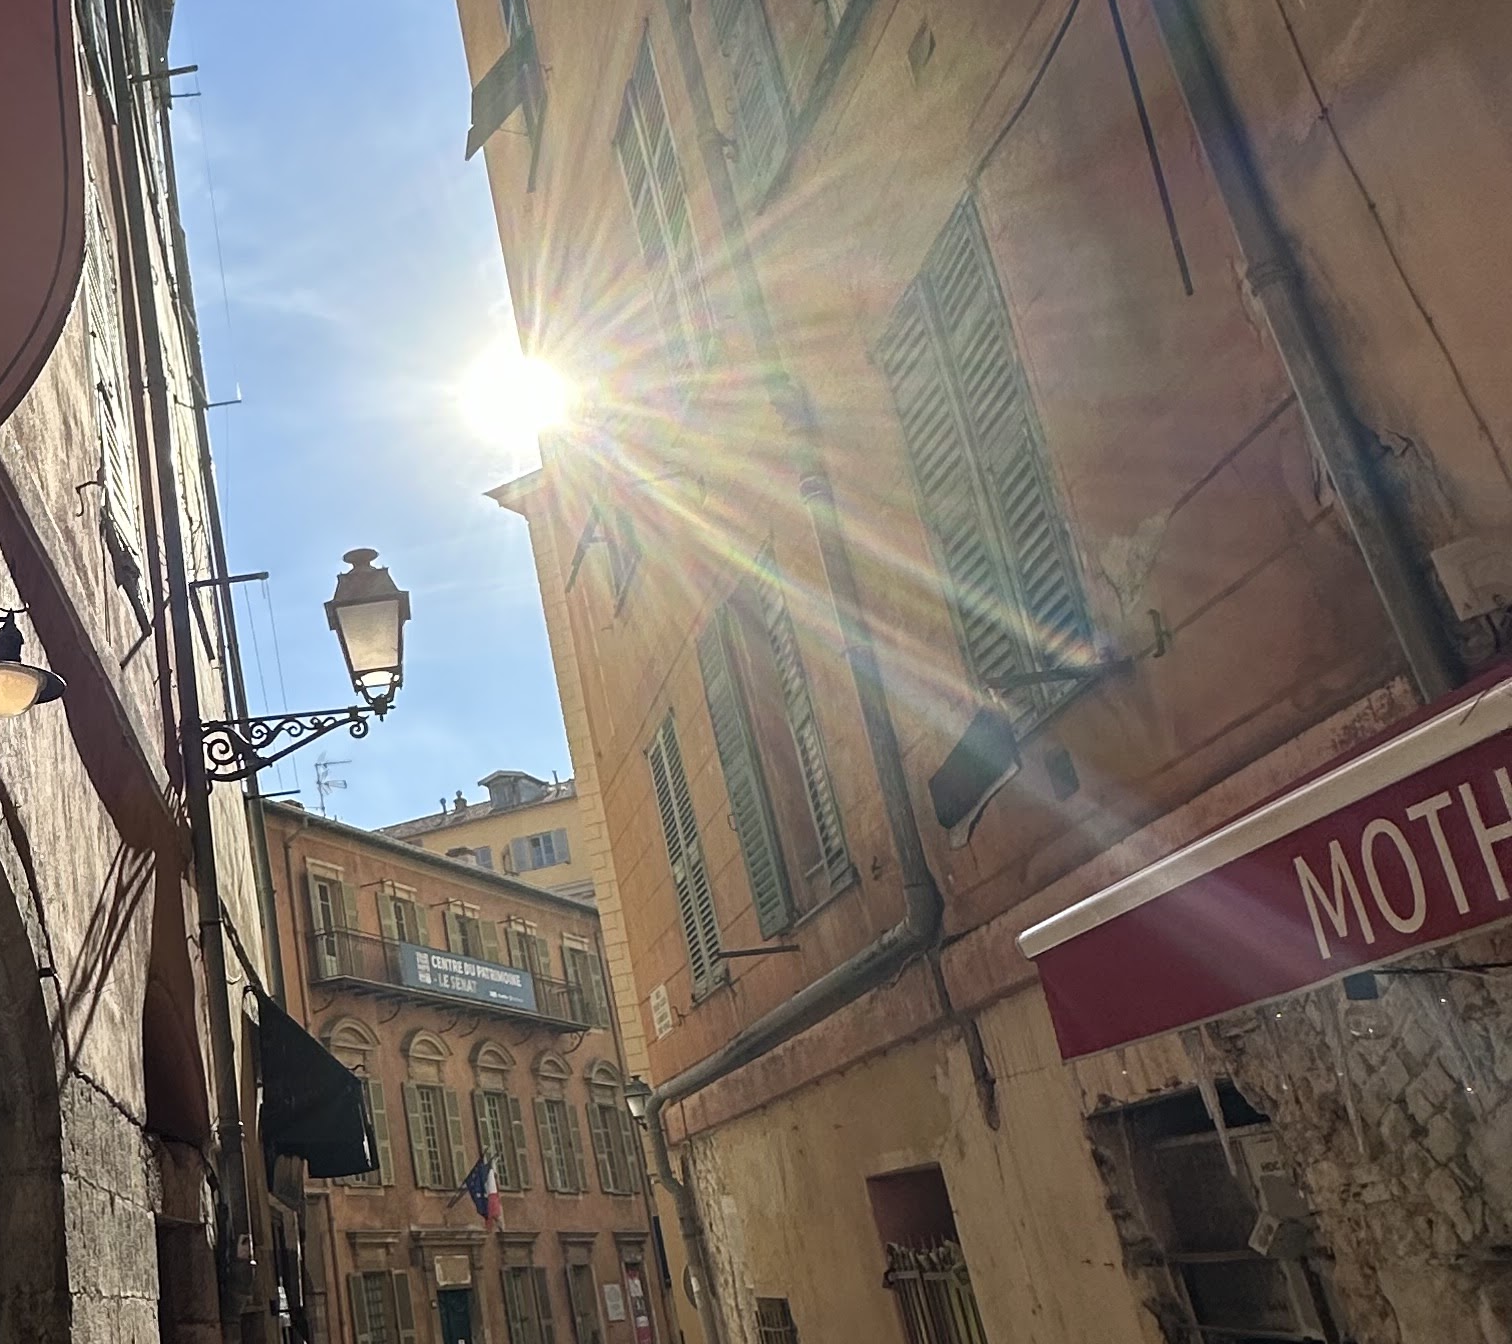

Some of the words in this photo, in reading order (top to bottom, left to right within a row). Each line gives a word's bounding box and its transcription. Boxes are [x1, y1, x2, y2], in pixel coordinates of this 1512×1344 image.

[431, 954, 463, 974] CENTRE
[463, 962, 476, 976] DU
[476, 965, 523, 988] PATRIMOINE
[438, 973, 450, 989] LE
